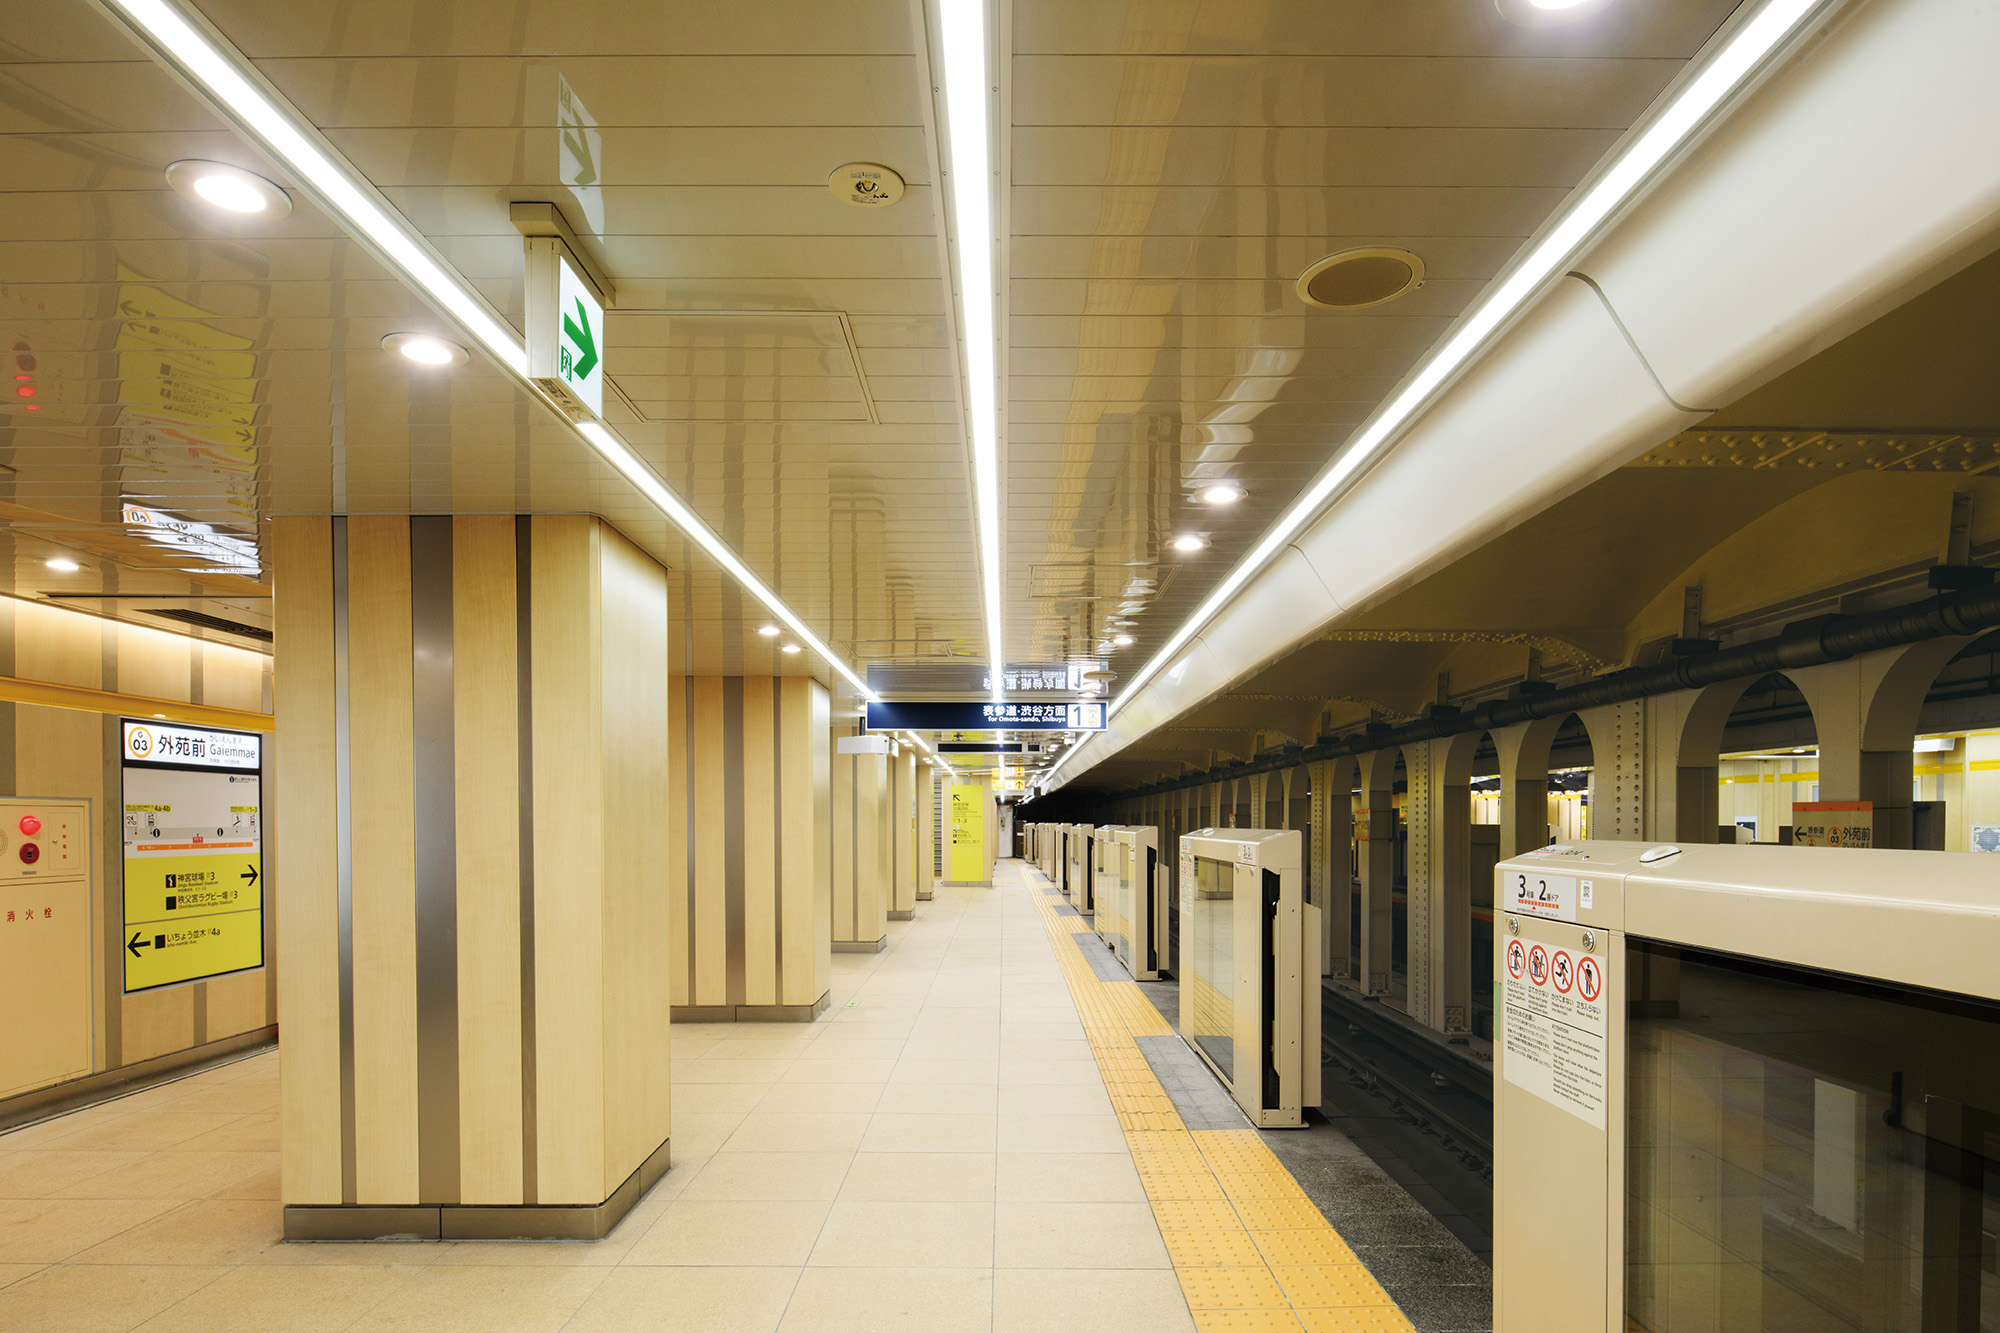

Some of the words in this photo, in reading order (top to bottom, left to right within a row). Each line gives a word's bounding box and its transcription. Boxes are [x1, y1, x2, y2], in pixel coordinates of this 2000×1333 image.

[983, 704, 1066, 717] 表参道・渋谷方面
[1073, 705, 1081, 726] 1
[1041, 716, 1066, 724] Shibuya
[133, 739, 148, 751] 03
[158, 734, 205, 758] 外苑前
[210, 743, 256, 759] Gaiemmae
[1830, 835, 1840, 843] 03
[1842, 826, 1871, 841] 外苑前
[210, 871, 216, 881] 3
[233, 890, 238, 899] 3
[7, 907, 52, 922] 消火栓
[167, 930, 206, 942] いちょう並木
[211, 928, 221, 936] 4a
